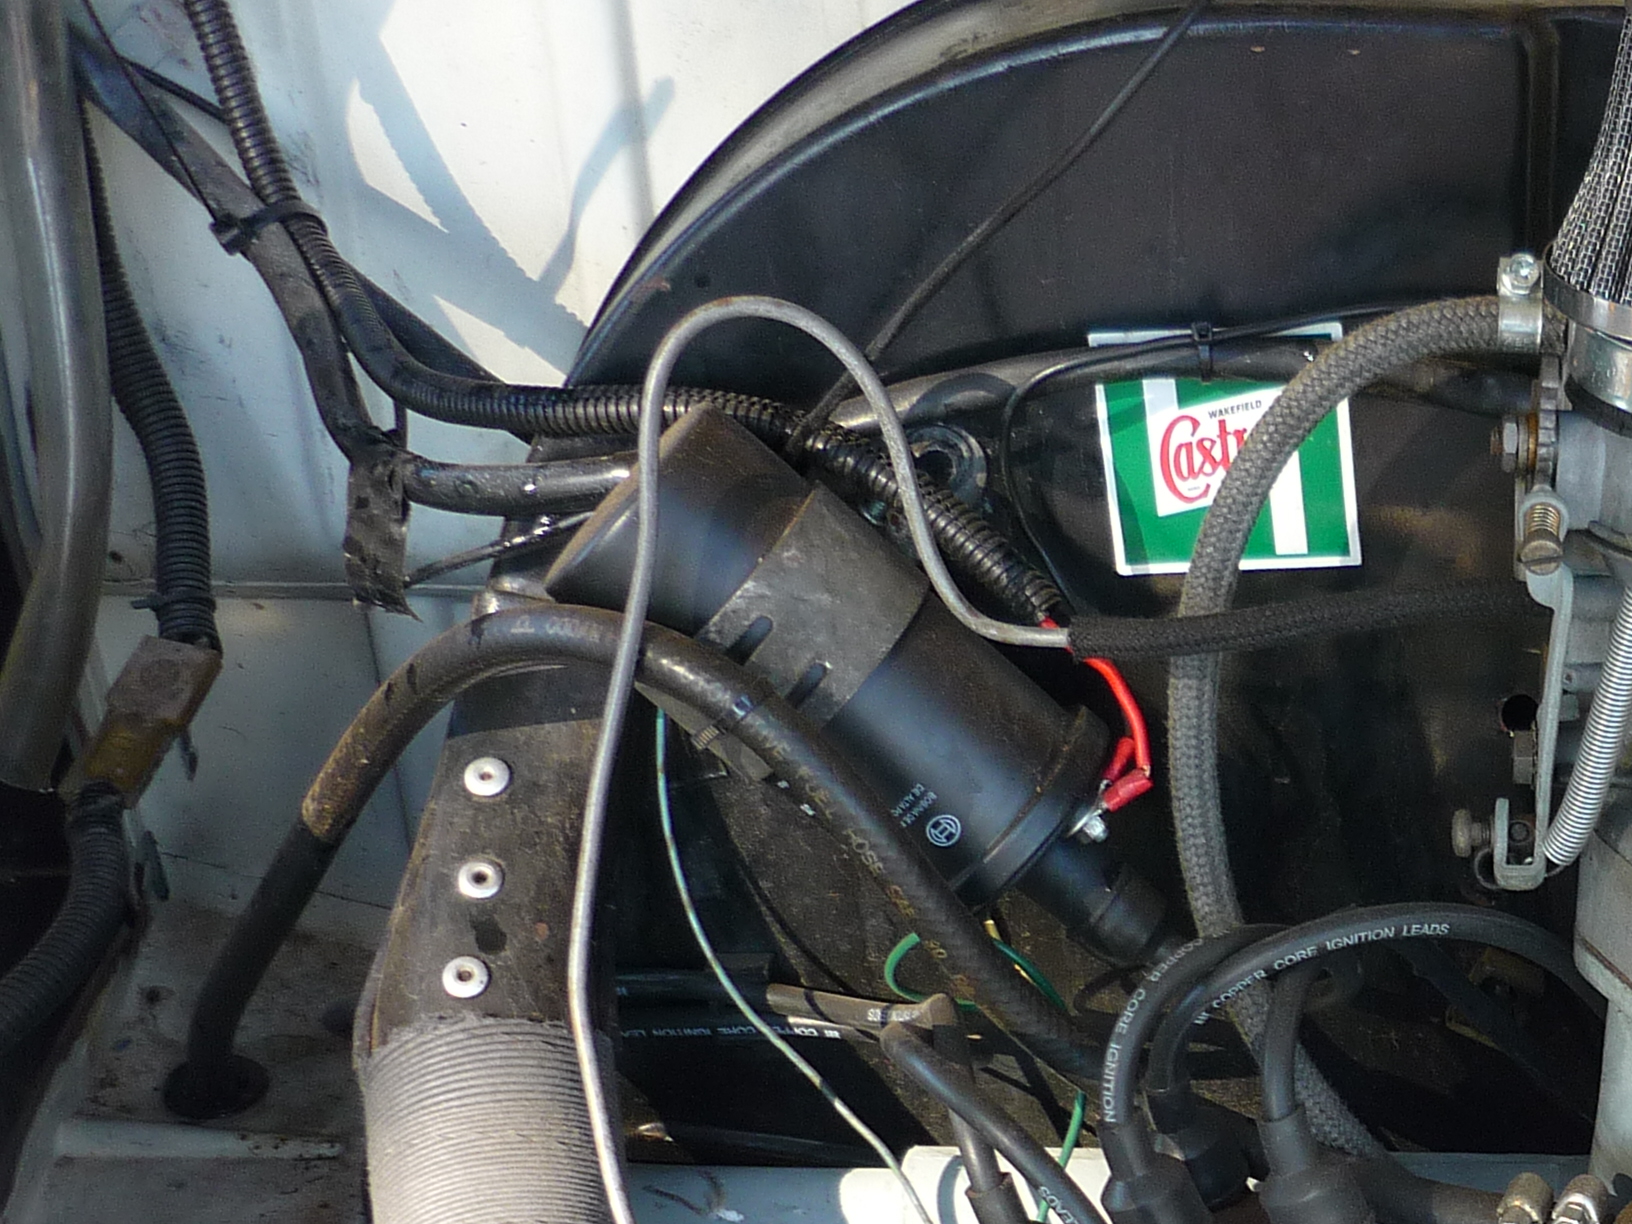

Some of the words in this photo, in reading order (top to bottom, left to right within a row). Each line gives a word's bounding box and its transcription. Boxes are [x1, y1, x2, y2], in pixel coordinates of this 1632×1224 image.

[1208, 400, 1262, 419] WAKEFIELD
[1160, 414, 1247, 504] Castr
[1212, 969, 1268, 1009] COPPER
[1274, 946, 1319, 970] CORE
[1326, 926, 1395, 951] IGNITION
[1402, 923, 1450, 937] LEADS
[1115, 988, 1147, 1035] CORE
[1102, 1043, 1122, 1123] IGNITION
